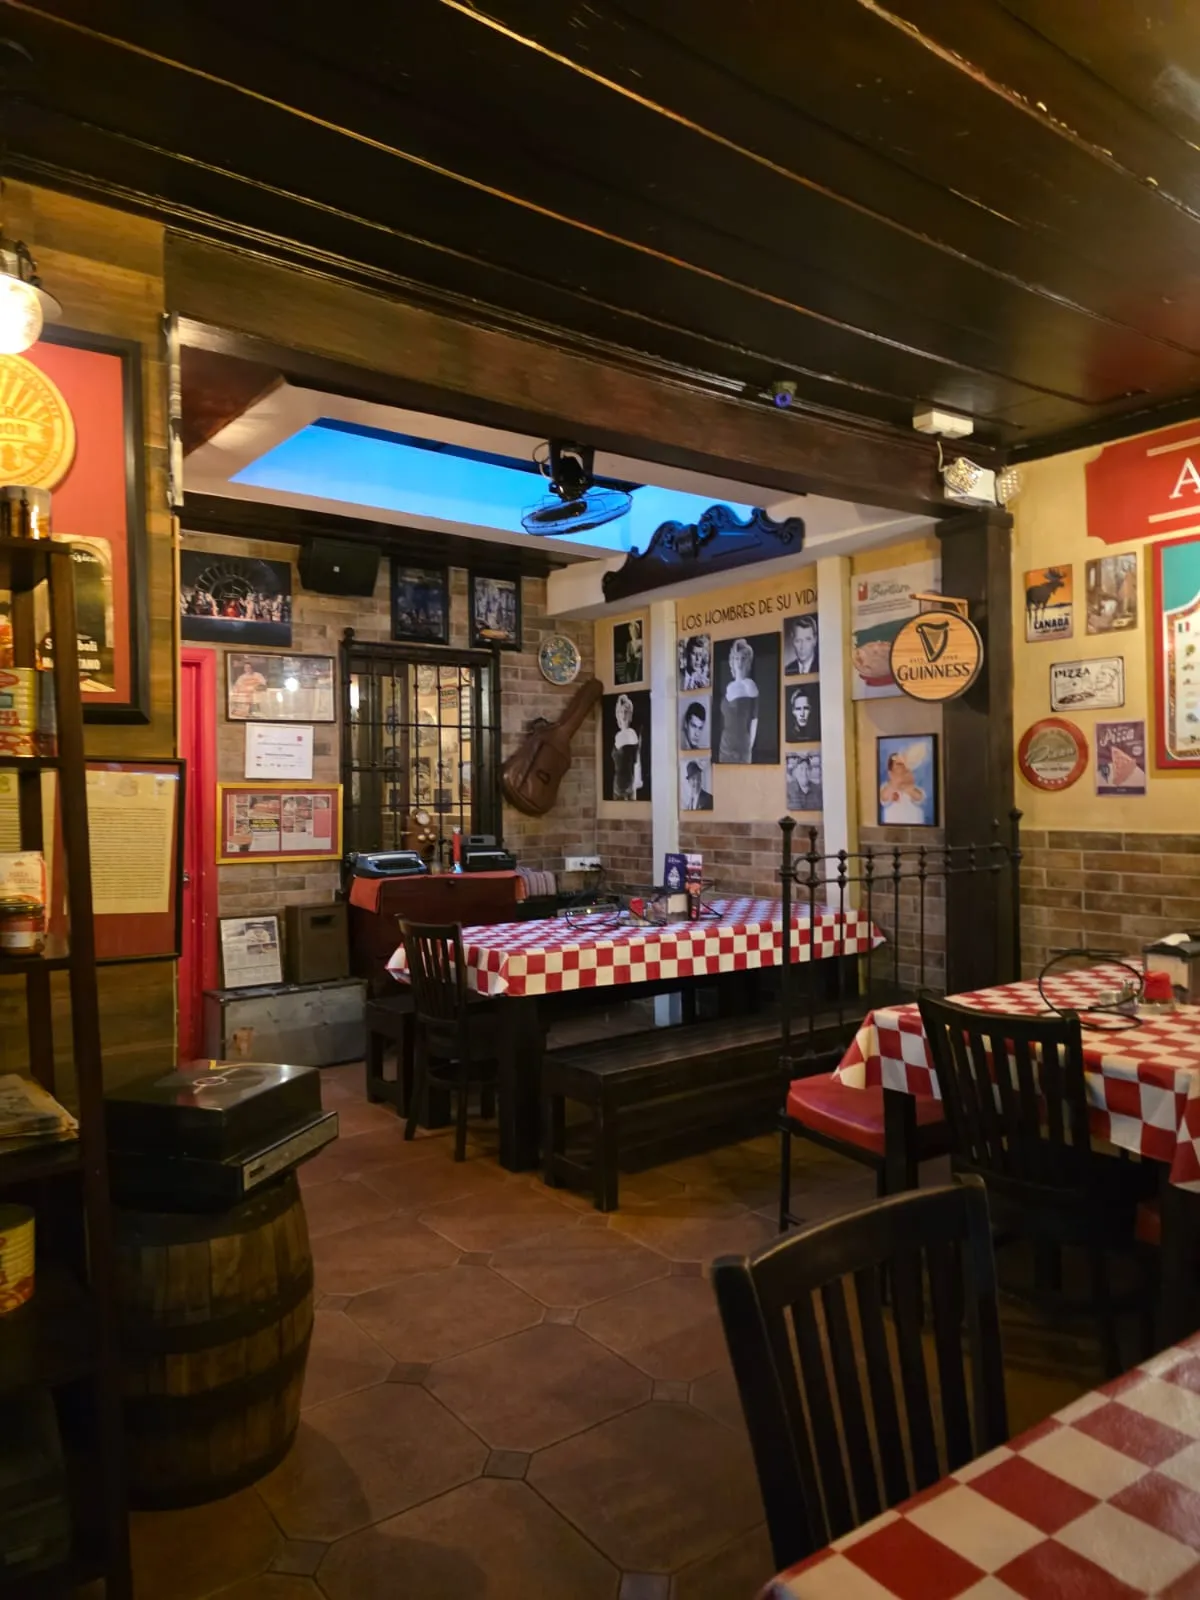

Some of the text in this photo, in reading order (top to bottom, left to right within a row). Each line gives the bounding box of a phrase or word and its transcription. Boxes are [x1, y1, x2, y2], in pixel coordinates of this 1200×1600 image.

[681, 613, 702, 631] LOS
[704, 601, 756, 627] HOMBRES
[758, 597, 774, 615] DE
[776, 593, 792, 611] SU
[896, 662, 970, 682] GUINNESS
[1054, 667, 1090, 679] PIZZA
